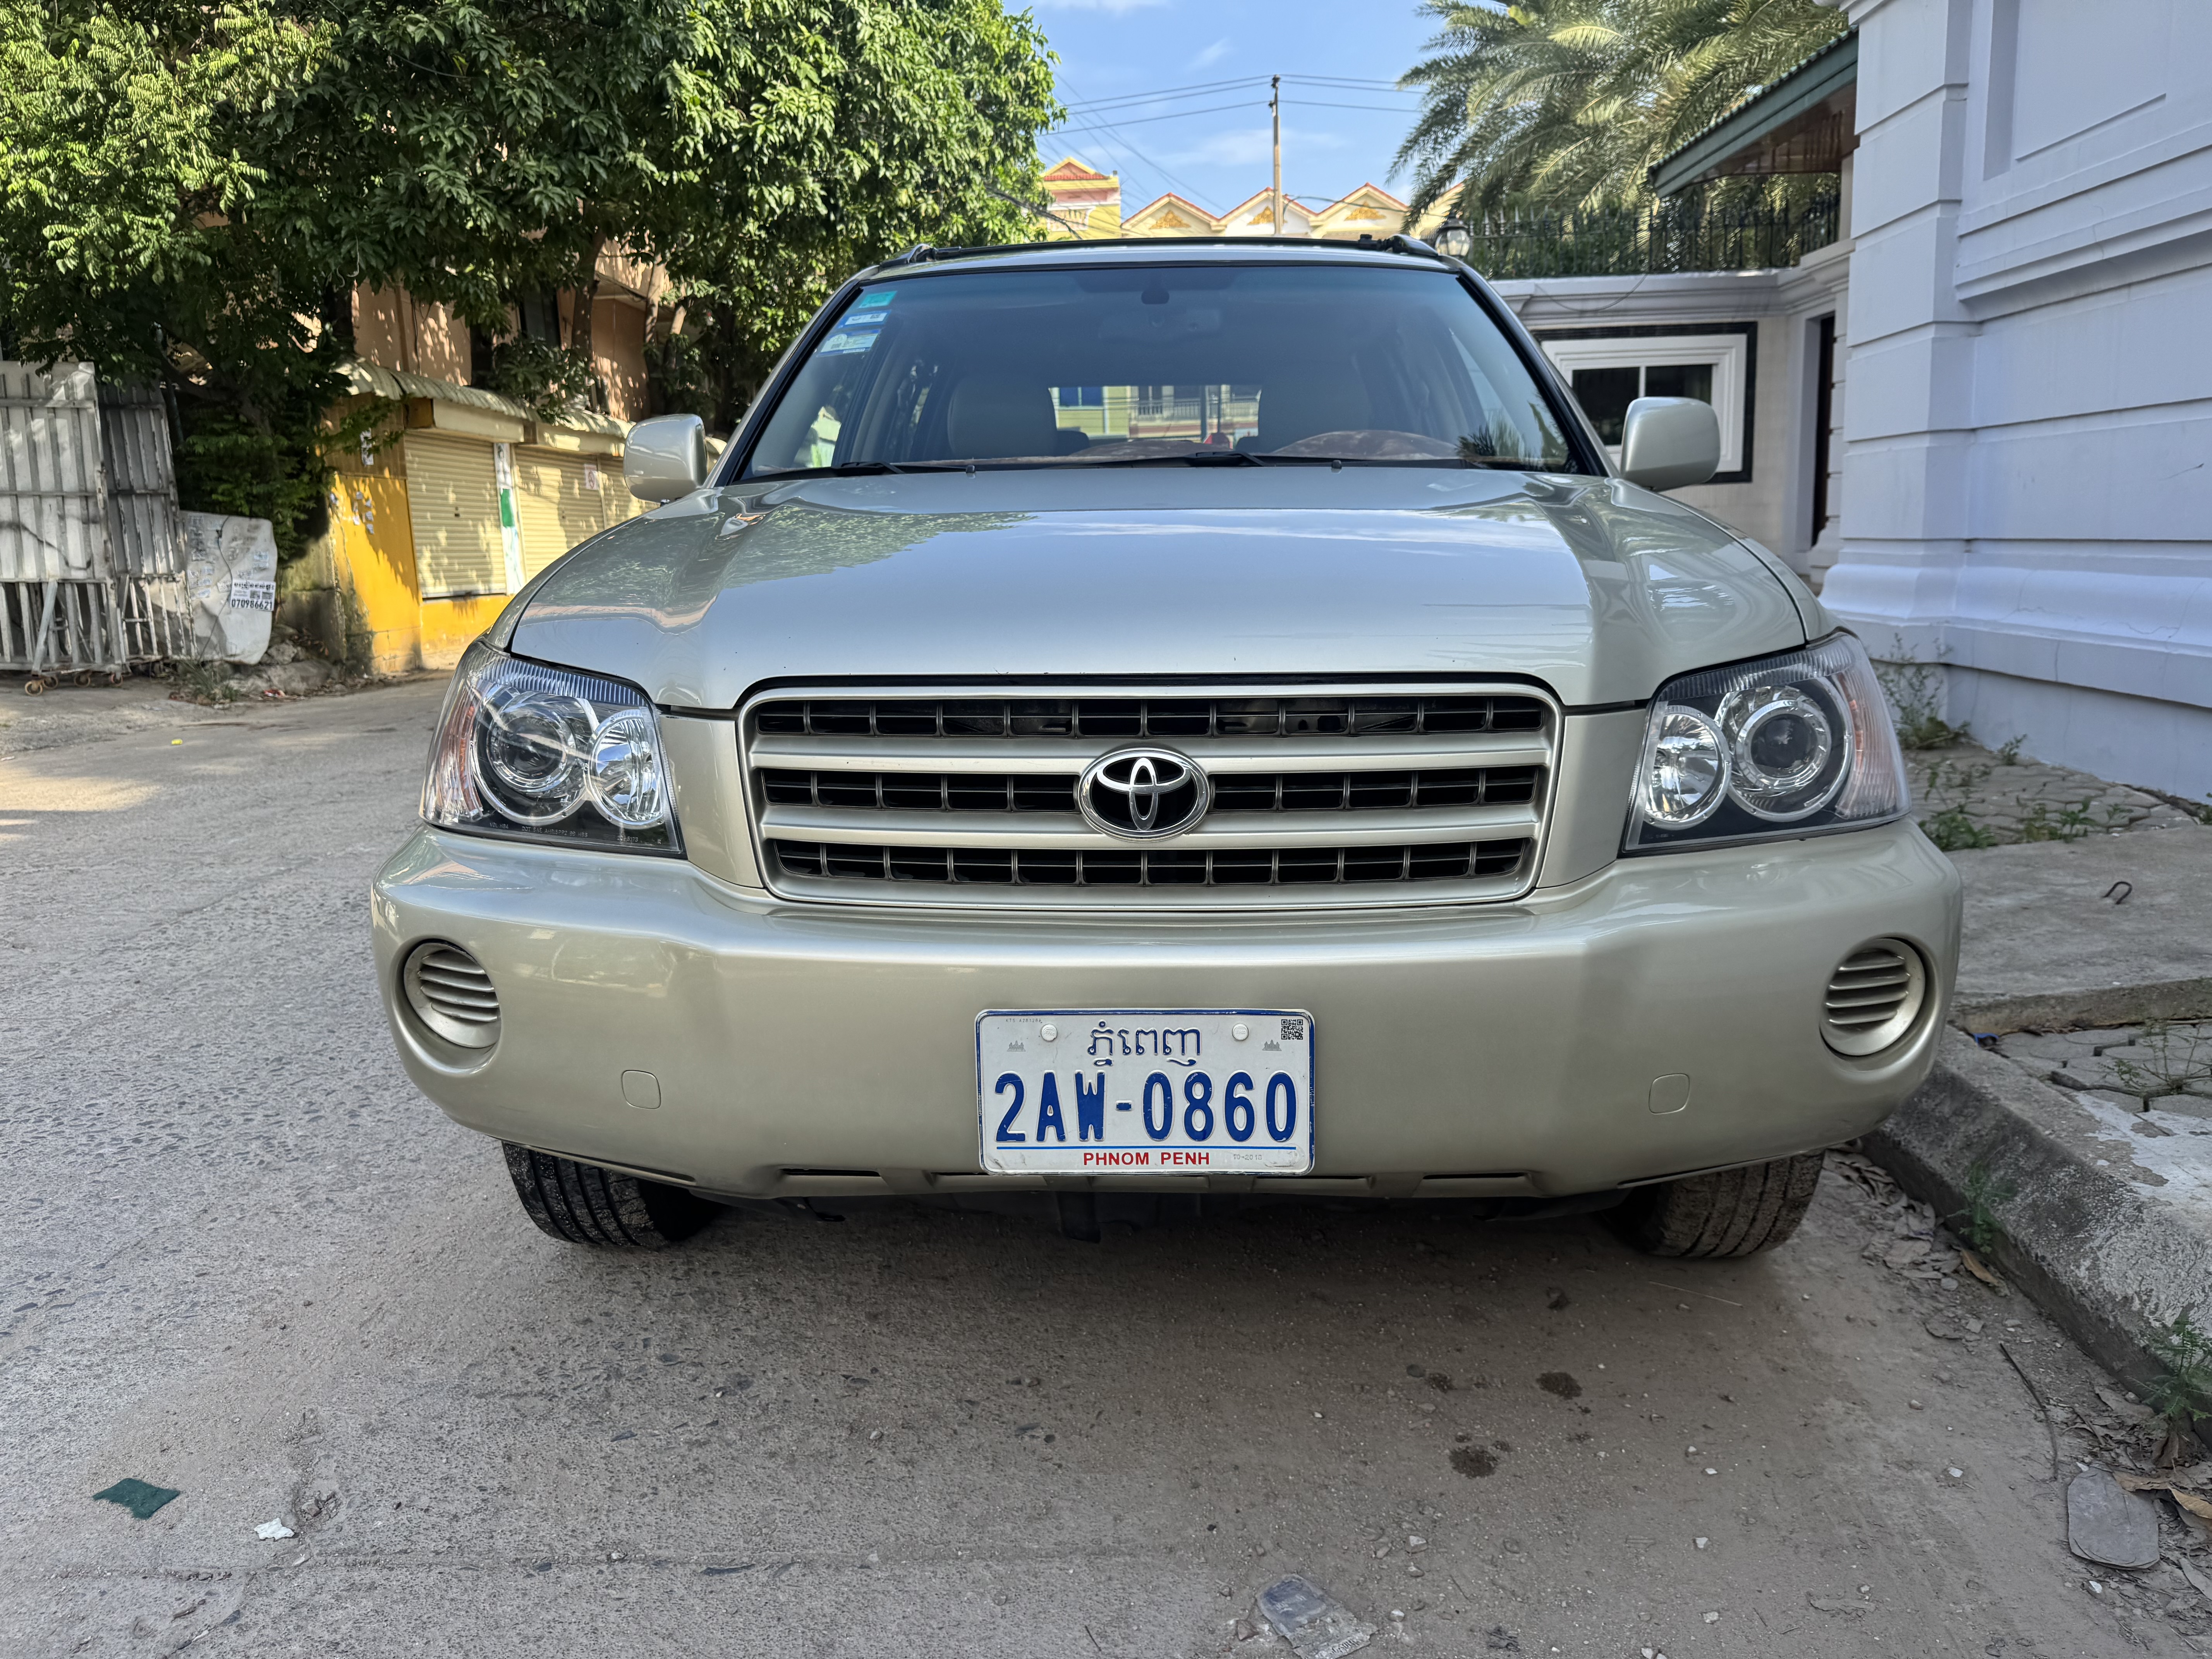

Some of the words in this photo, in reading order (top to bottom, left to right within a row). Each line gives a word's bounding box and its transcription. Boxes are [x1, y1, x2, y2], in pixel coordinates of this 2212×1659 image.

[231, 599, 272, 610] 070986621
[1087, 1019, 1201, 1067] ភ្នំពេញ
[994, 1070, 1297, 1143] 2AW-0860
[1083, 1152, 1149, 1166] PHNOM
[1161, 1152, 1210, 1166] PENH
